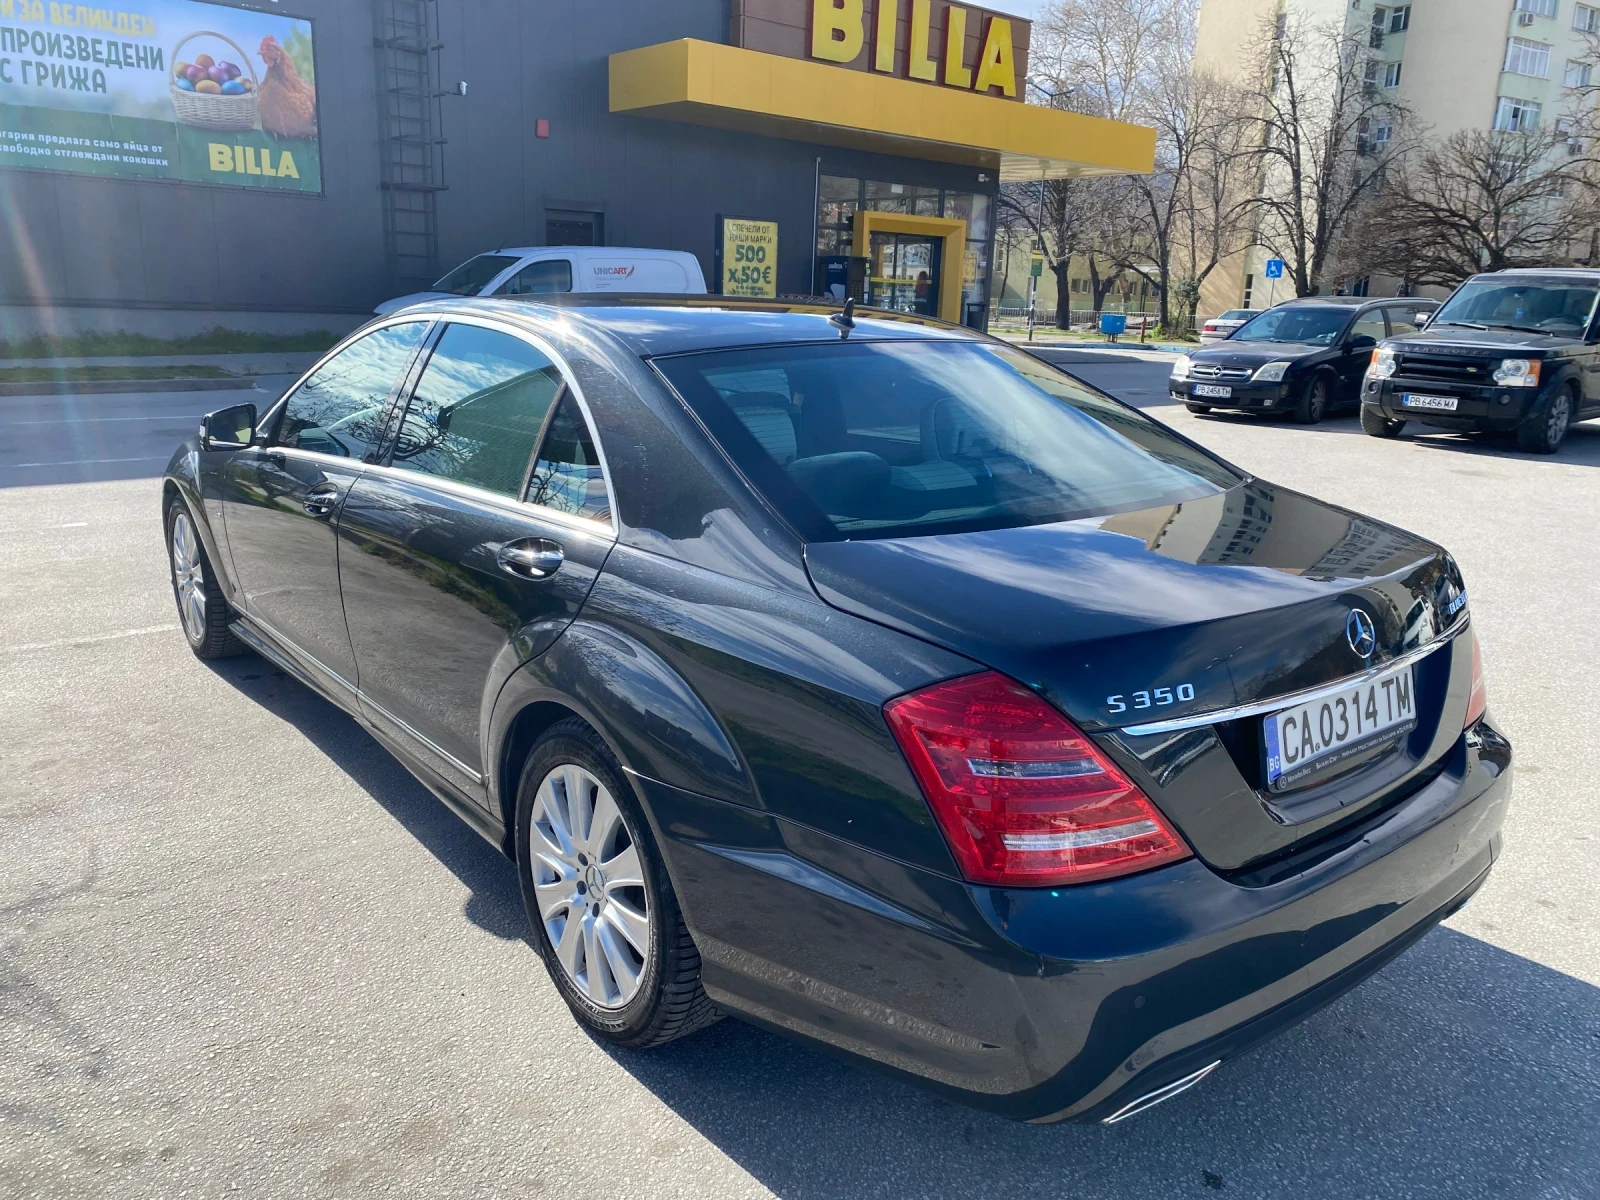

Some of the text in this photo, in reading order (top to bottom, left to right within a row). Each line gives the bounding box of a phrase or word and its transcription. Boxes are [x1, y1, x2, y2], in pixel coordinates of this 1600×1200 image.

[0, 26, 164, 71] ПРОИЗВЕДЕНИ
[807, 0, 1017, 97] BILLA
[0, 57, 107, 93] С ГРИЖА
[38, 134, 91, 146] предлага
[93, 139, 120, 149] само
[123, 141, 149, 153] яйца
[151, 145, 163, 153] от
[54, 149, 120, 162] отглеждани
[122, 154, 168, 166] кокошки
[208, 143, 299, 179] BILLA
[731, 223, 770, 234] СПЕЧЕЛИ ОТ
[729, 233, 772, 244] НАШИ МАРКИ
[734, 244, 766, 263] 500
[593, 267, 627, 275] UNICART
[1410, 396, 1455, 409] PB 6456 MA
[1106, 683, 1196, 714] S 350
[1269, 755, 1280, 772] BG
